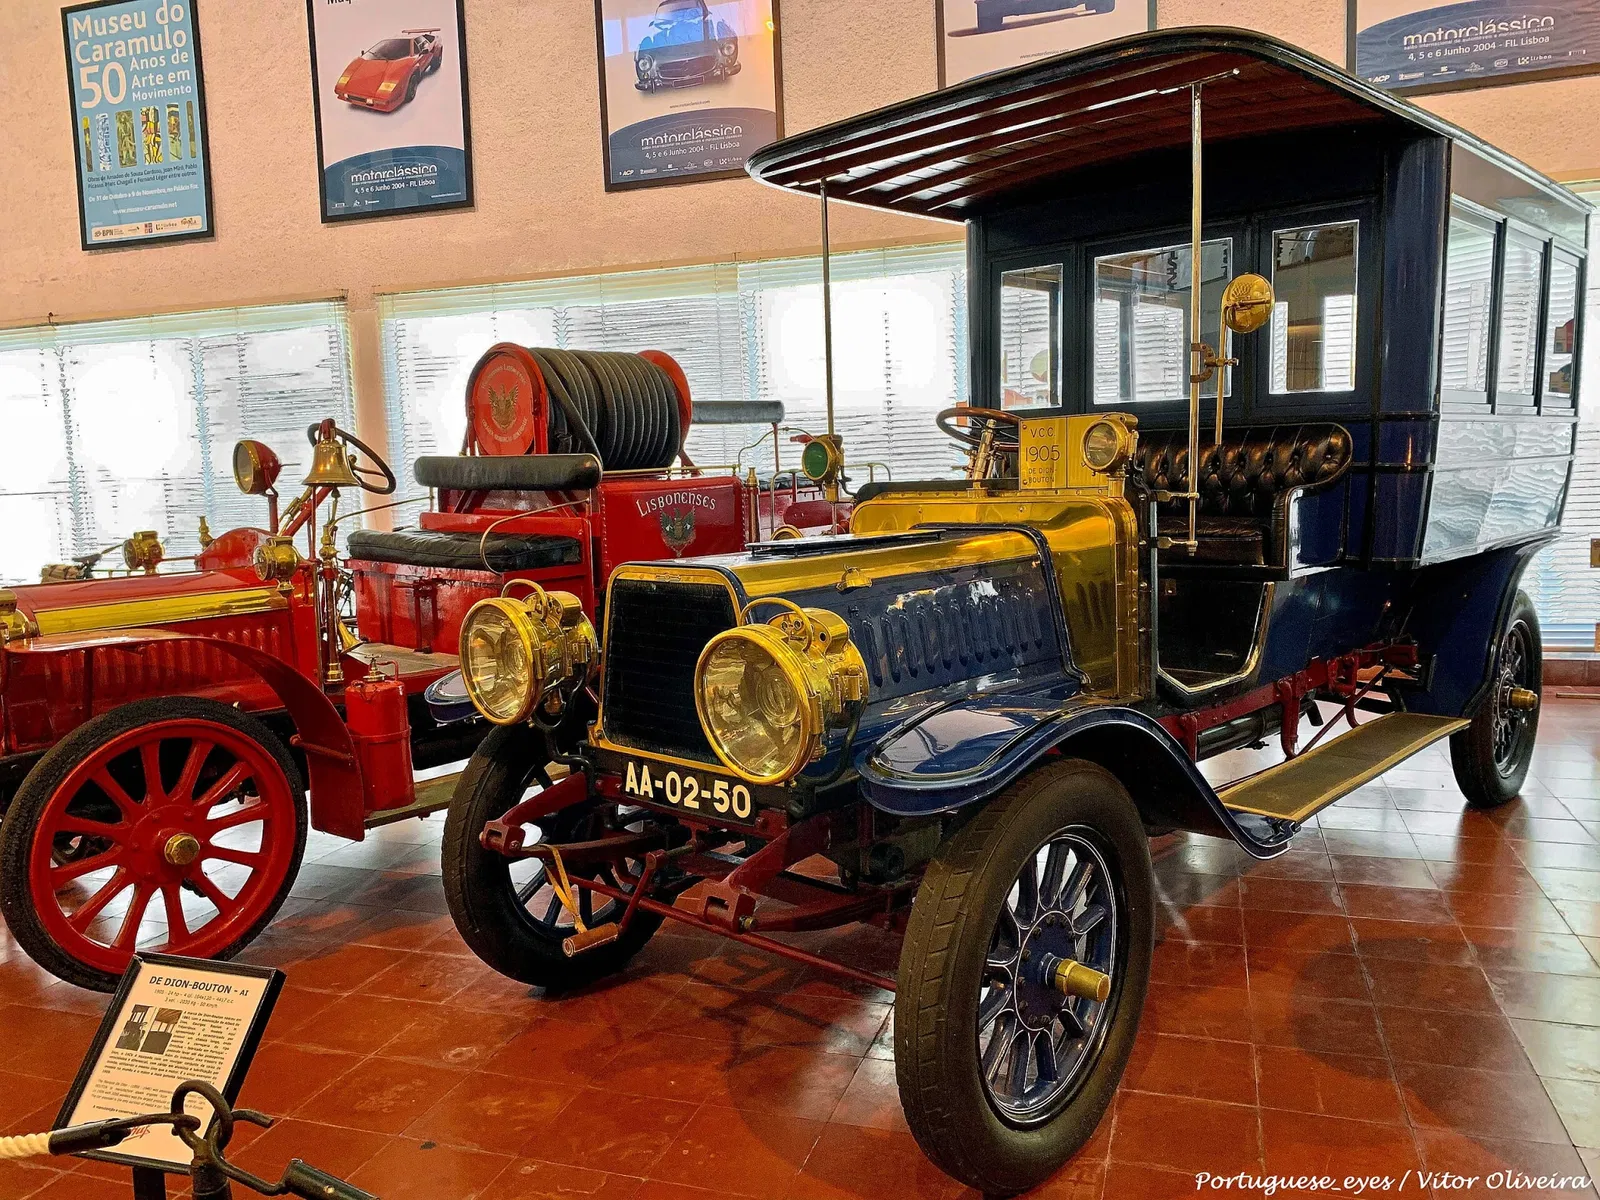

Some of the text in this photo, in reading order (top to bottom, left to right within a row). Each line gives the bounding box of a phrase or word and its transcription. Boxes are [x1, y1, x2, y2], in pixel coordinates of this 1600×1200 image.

[72, 0, 184, 40] Museu do
[1403, 14, 1554, 46] motorclássico
[75, 24, 187, 64] Caramulo
[1408, 53, 1416, 62] 4,
[1418, 51, 1424, 60] 5
[1435, 49, 1442, 57] 6
[1443, 45, 1471, 56] Junho
[1472, 42, 1496, 52] 2004
[1505, 38, 1518, 48] FIL
[1520, 36, 1550, 46] Lisboa
[129, 48, 189, 72] Anos de
[79, 61, 127, 109] 50
[131, 69, 191, 89] Arte em
[132, 85, 192, 102] Movimento
[641, 124, 742, 147] motorclássico
[645, 152, 651, 160] 4,
[669, 148, 687, 156] Junho
[351, 164, 438, 182] motorclássico
[375, 184, 391, 192] Junho
[392, 182, 405, 190] 2004
[1026, 444, 1060, 462] 1905
[624, 761, 751, 818] AA-02-50
[149, 976, 163, 985] DE
[164, 978, 232, 994] DION-BOUTON
